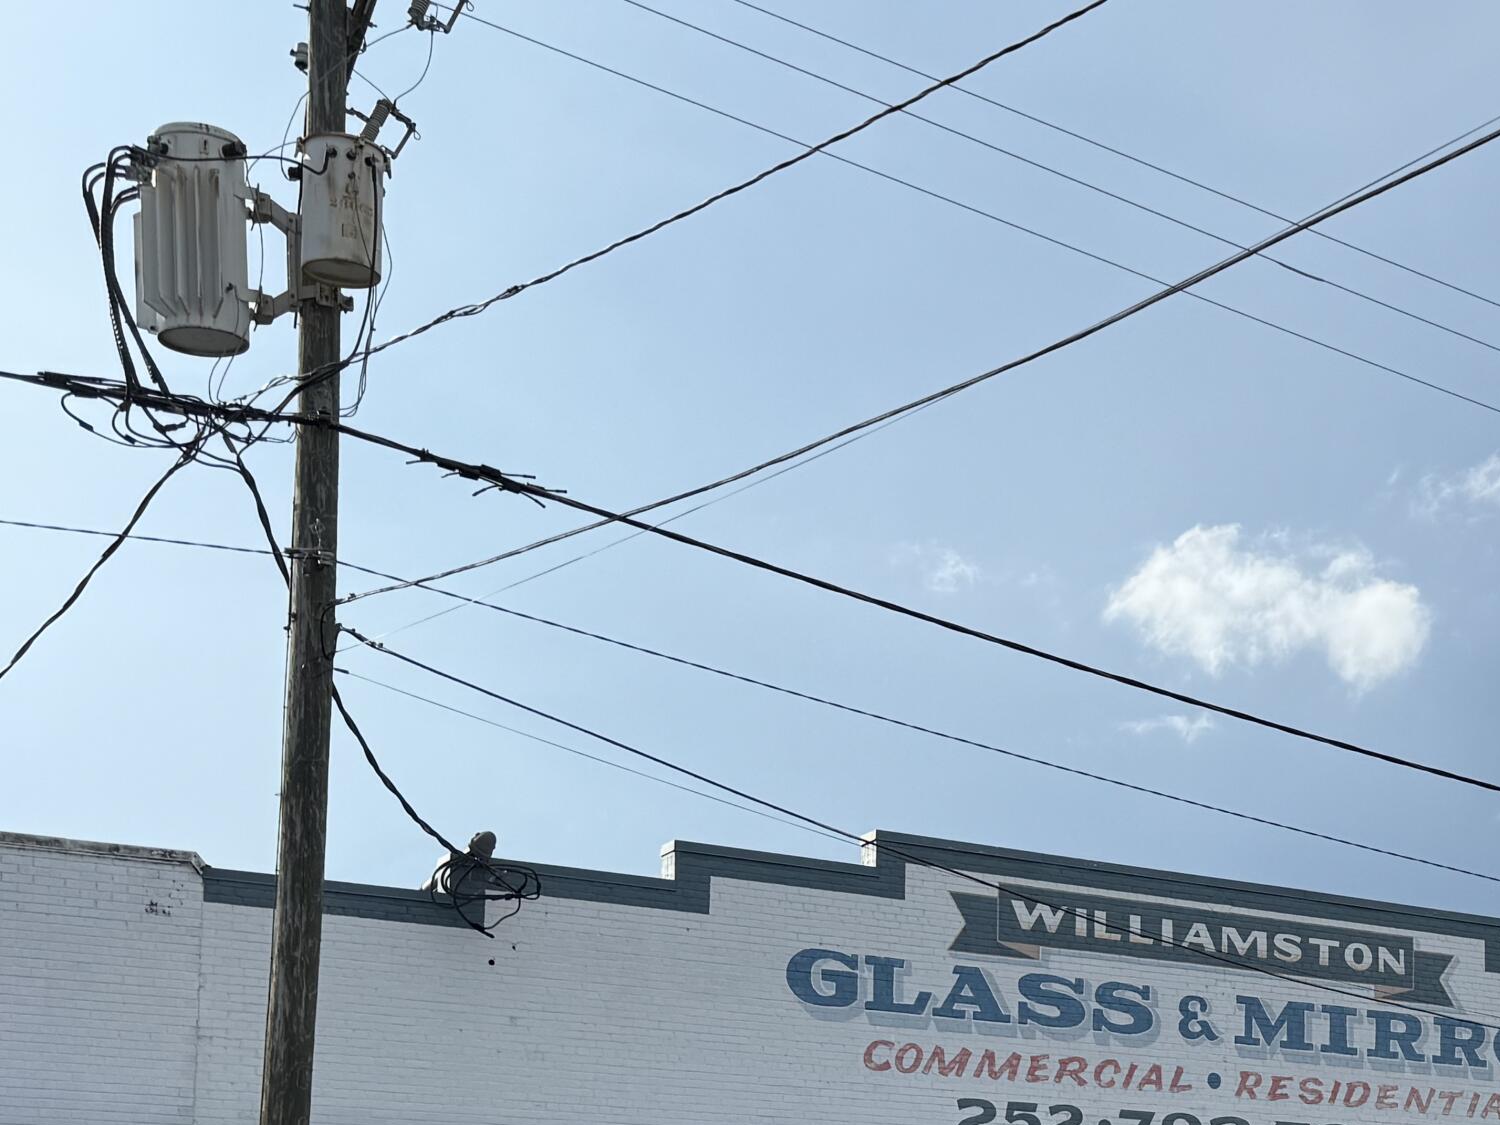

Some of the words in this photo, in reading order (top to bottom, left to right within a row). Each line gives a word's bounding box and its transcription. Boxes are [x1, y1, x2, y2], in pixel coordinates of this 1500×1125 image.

[1009, 898, 1406, 976] WILLIAMSTON
[785, 947, 1158, 1038] GLASS
[1178, 994, 1218, 1042] &
[863, 1039, 1193, 1093] COMMERCIAL
